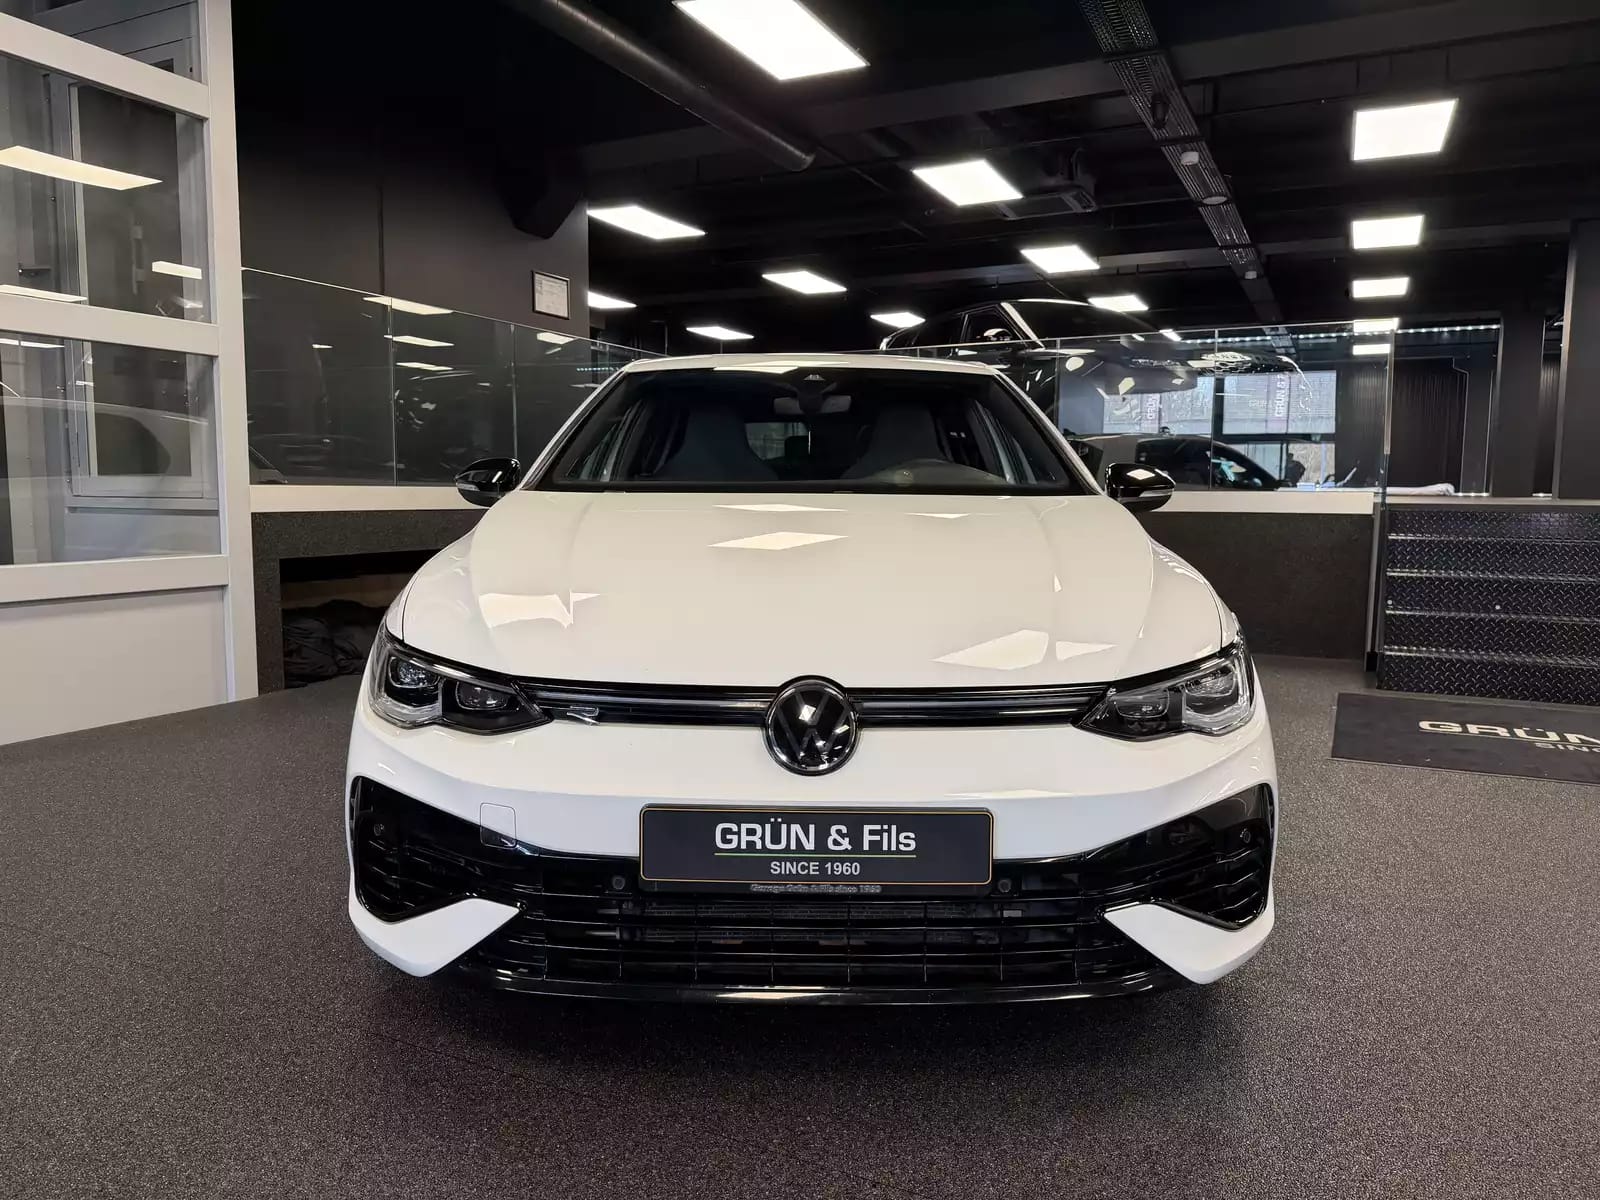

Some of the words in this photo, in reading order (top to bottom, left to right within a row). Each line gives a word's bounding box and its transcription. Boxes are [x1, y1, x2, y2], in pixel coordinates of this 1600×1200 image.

[715, 818, 815, 850] GRÜN
[827, 825, 852, 850] &
[863, 824, 916, 851] Fils
[770, 861, 819, 875] SINCE
[824, 862, 860, 876] 1960
